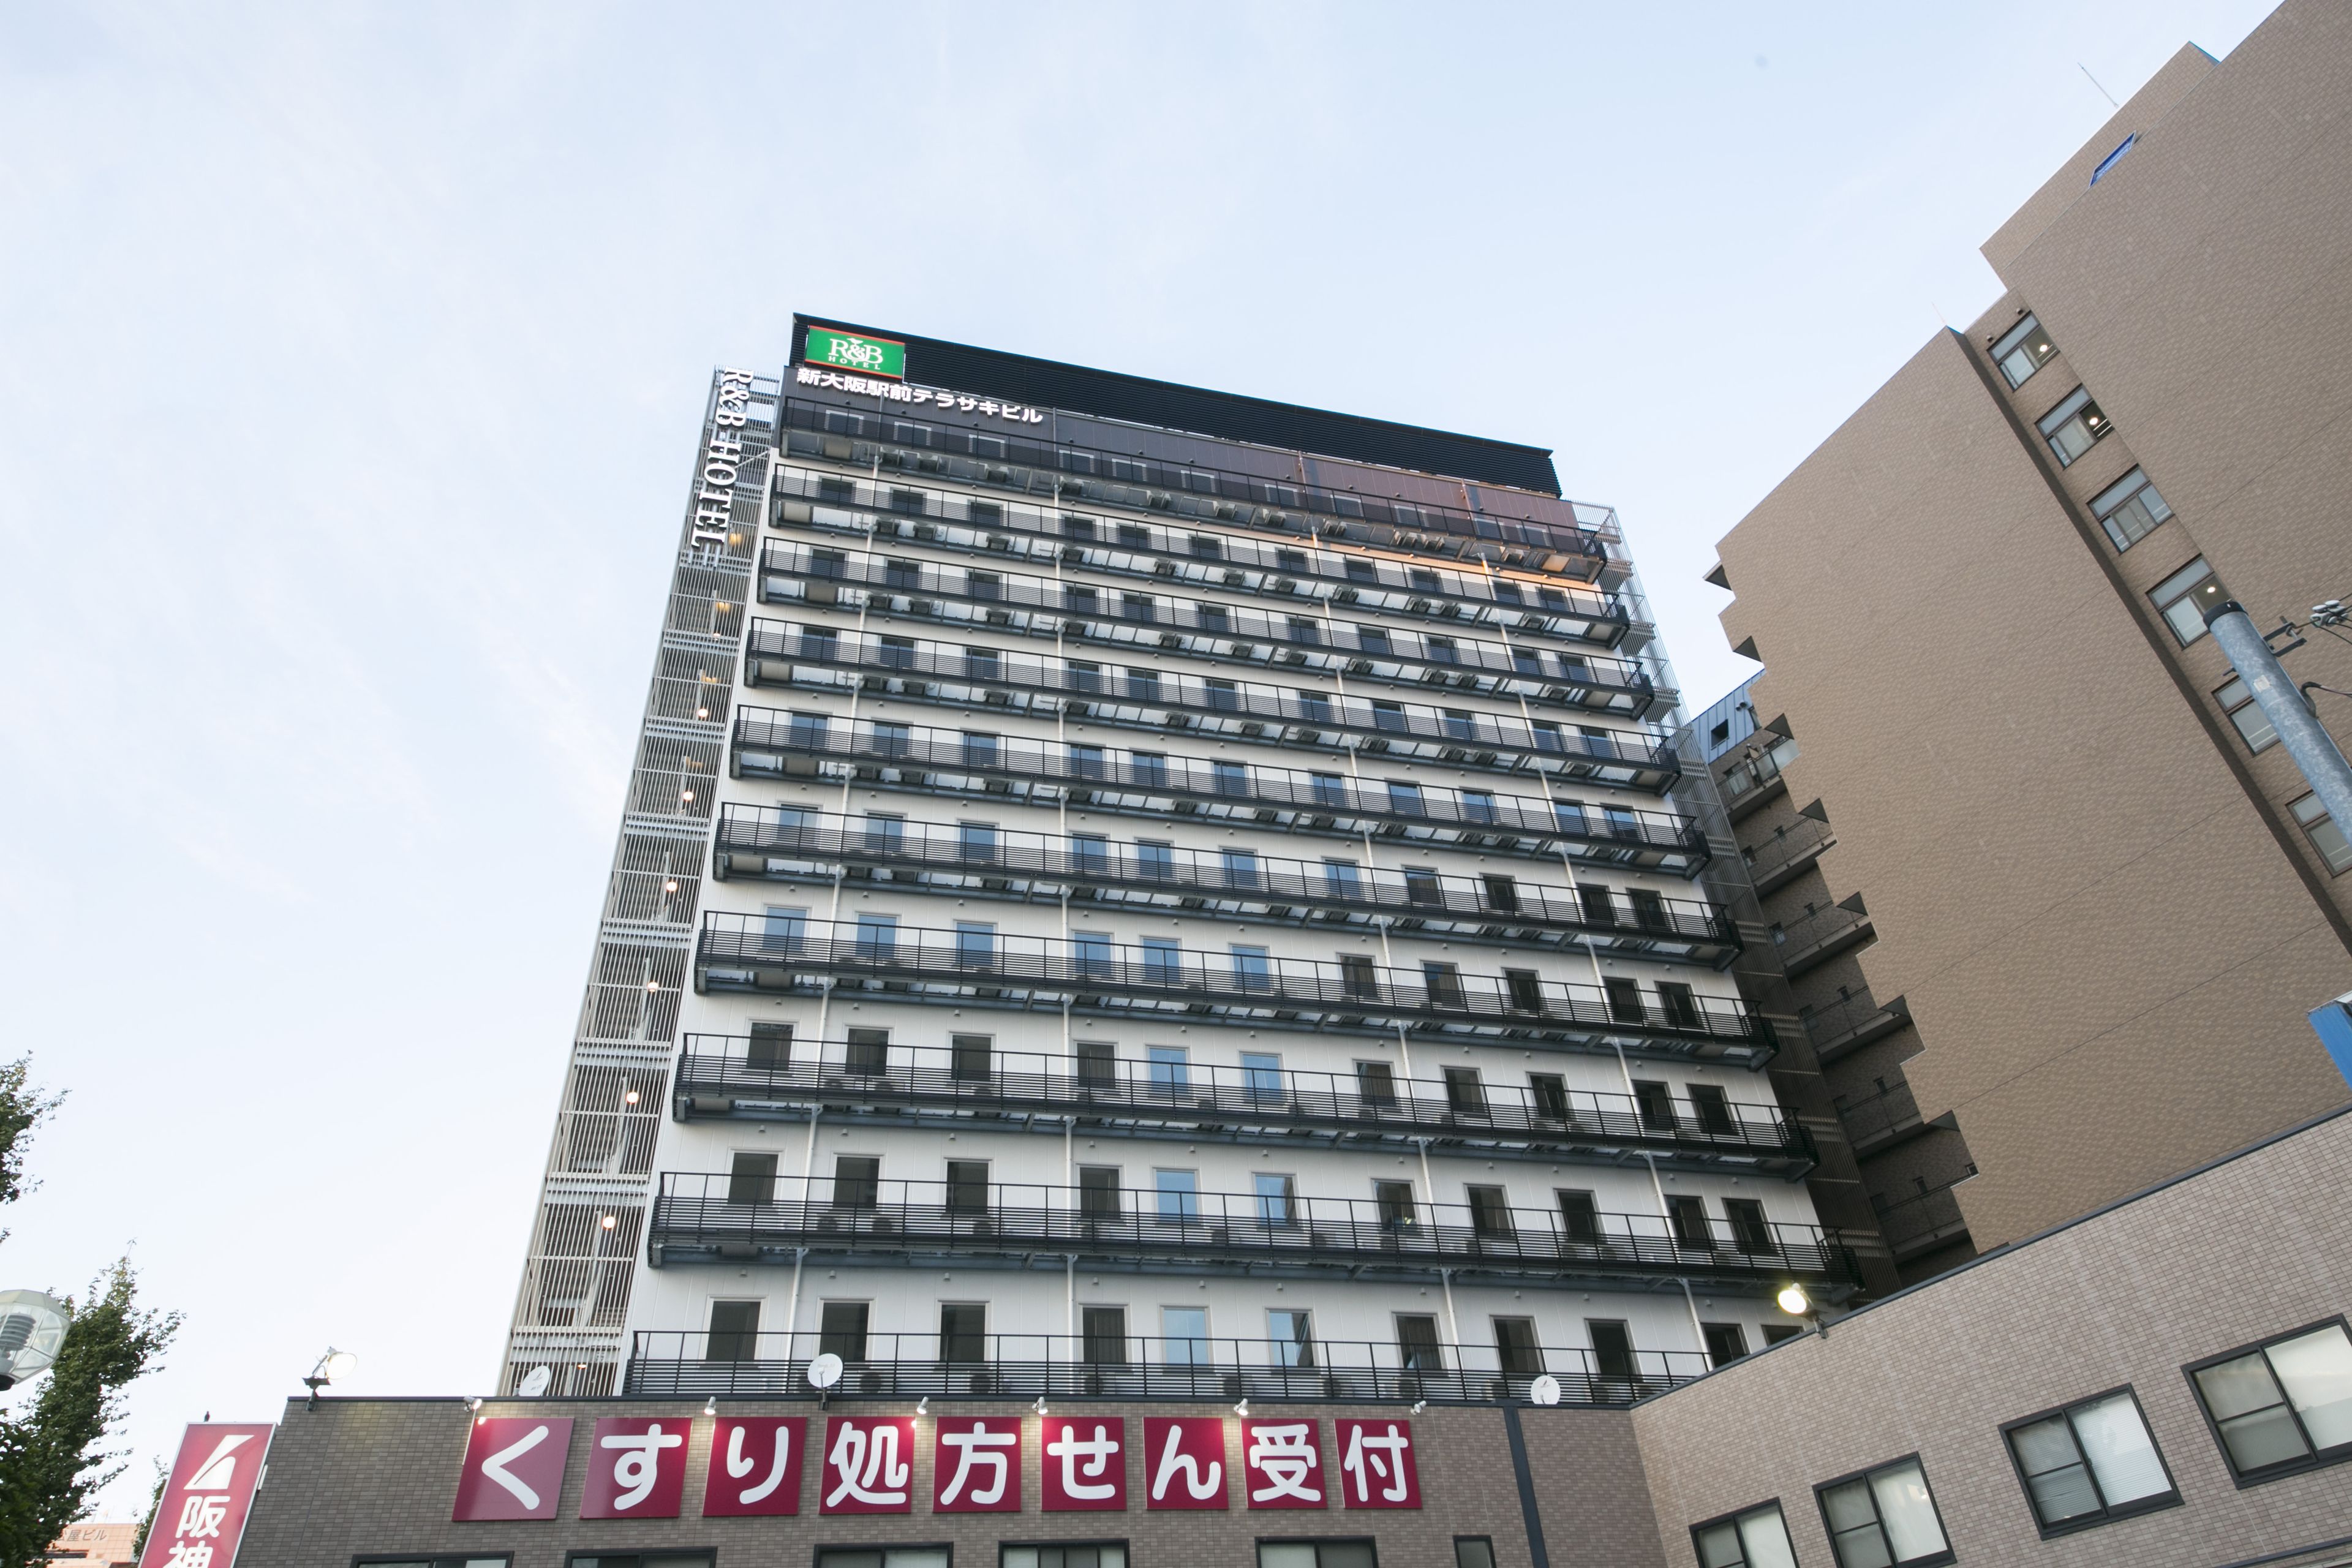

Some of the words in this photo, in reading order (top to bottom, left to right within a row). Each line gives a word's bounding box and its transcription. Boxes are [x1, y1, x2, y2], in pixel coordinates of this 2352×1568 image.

[829, 339, 883, 364] R&B
[829, 356, 880, 370] HOTEL
[715, 367, 754, 427] R&B
[797, 368, 1043, 423] 新大阪駅前テラサキビル
[692, 437, 741, 547] HOTEL
[481, 1422, 1408, 1510] くすり処方せん受付
